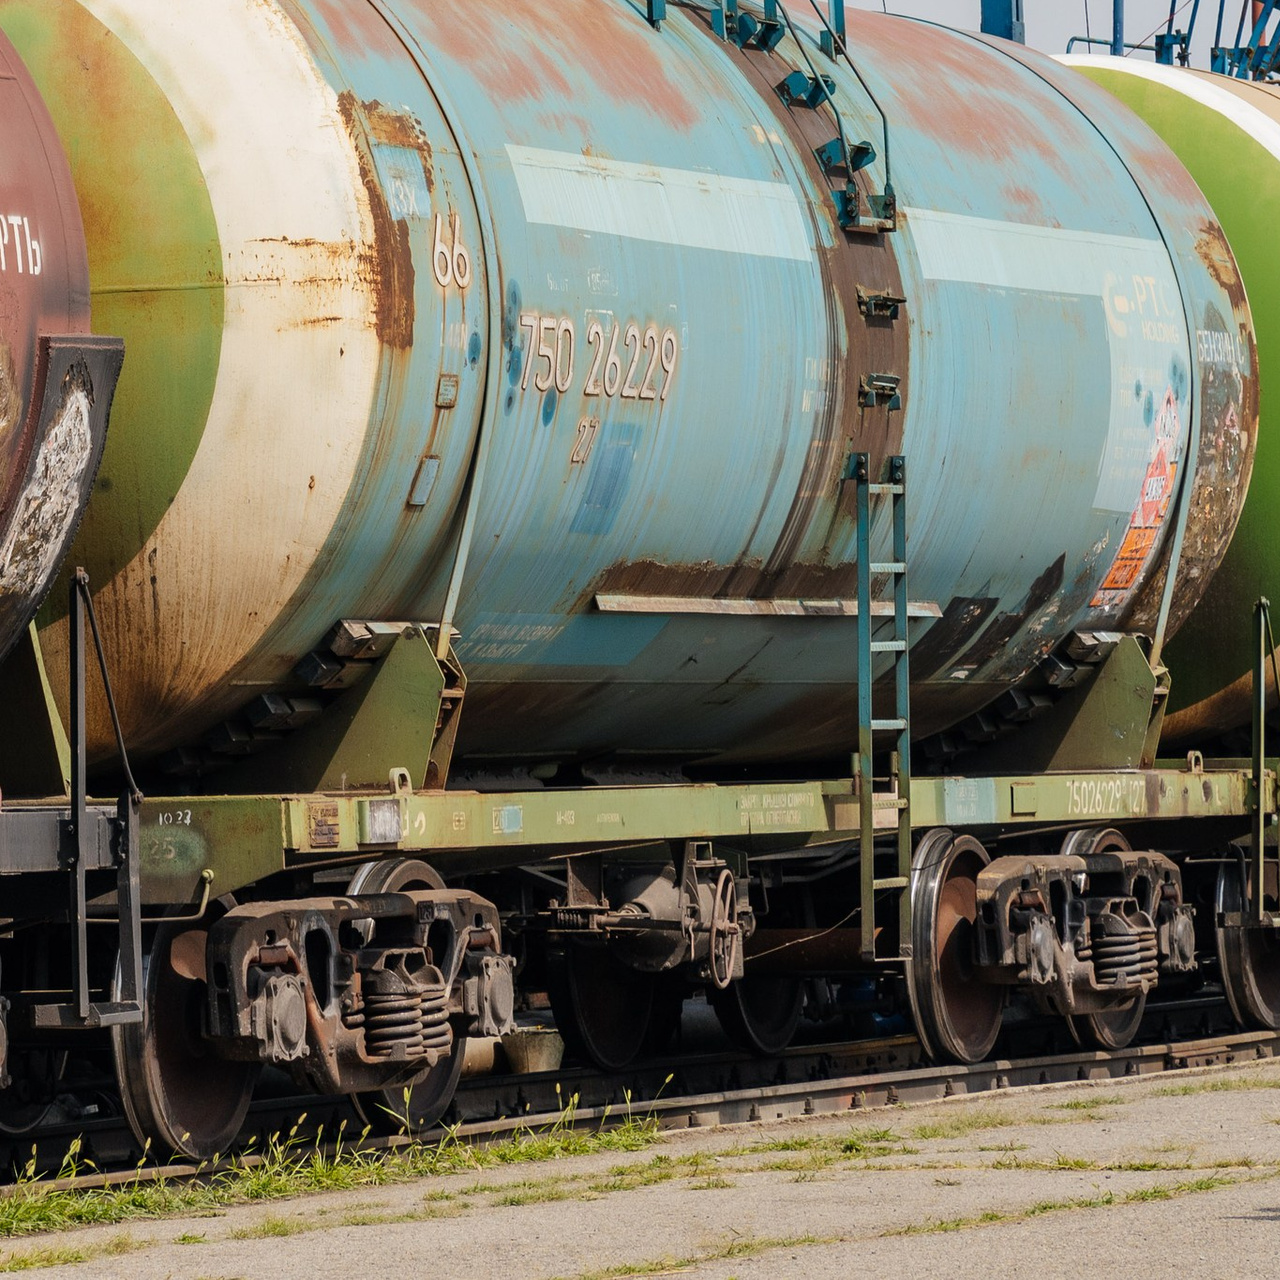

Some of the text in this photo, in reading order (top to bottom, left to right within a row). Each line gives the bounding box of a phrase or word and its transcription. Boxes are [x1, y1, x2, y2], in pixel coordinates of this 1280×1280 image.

[433, 212, 471, 289] 66
[520, 314, 677, 401] 750 26229
[571, 417, 599, 463] 27
[1066, 779, 1122, 814] 75026229
